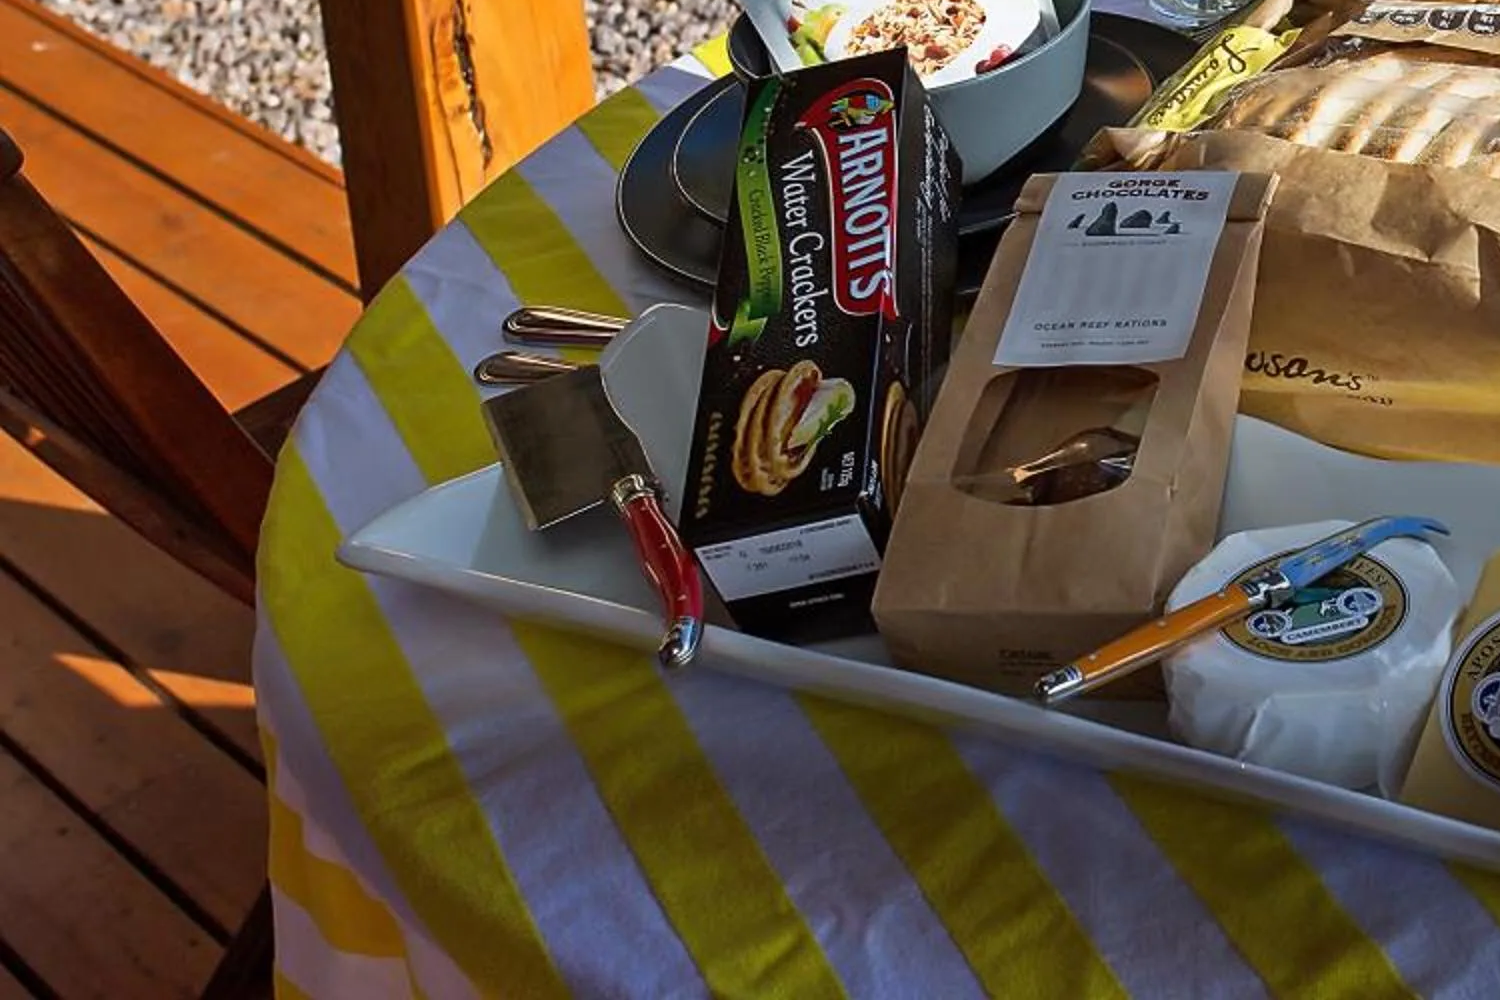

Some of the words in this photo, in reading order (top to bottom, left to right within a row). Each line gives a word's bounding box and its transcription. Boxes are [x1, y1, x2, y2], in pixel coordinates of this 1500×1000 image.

[779, 150, 816, 228] Water
[1071, 187, 1209, 200] CHOCOLATES
[789, 231, 829, 348] Crackers
